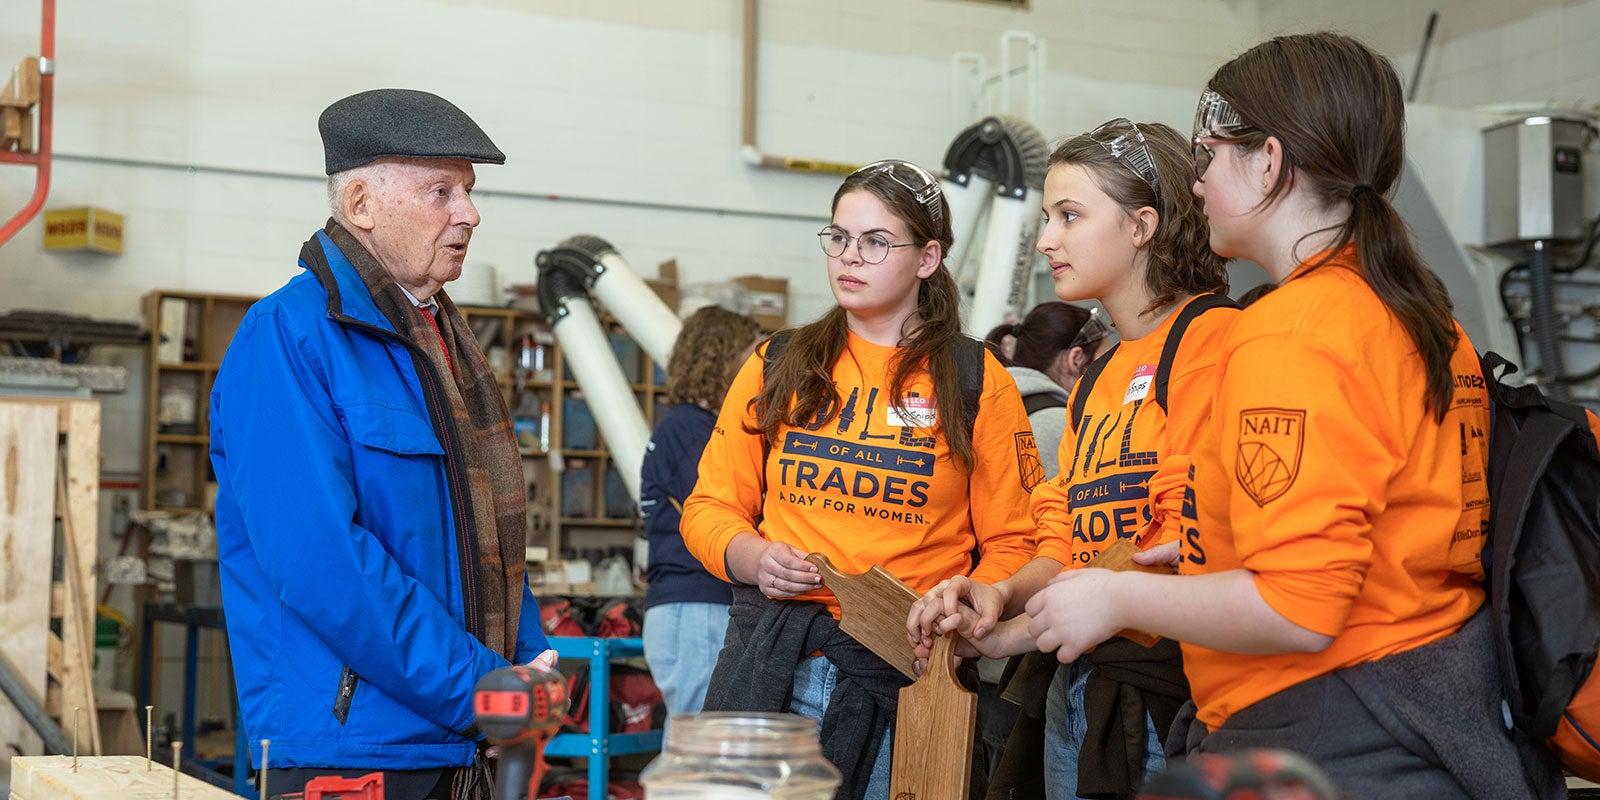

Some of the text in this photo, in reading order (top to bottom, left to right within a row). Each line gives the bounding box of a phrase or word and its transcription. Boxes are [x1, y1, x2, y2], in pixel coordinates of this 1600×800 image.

[1243, 416, 1297, 436] NAIT
[829, 444, 884, 464] OF ALL
[778, 458, 930, 508] TRADES
[1076, 484, 1110, 501] OF ALL
[779, 490, 924, 525] A DAY FOR WOMEN
[1071, 503, 1153, 543] ADES
